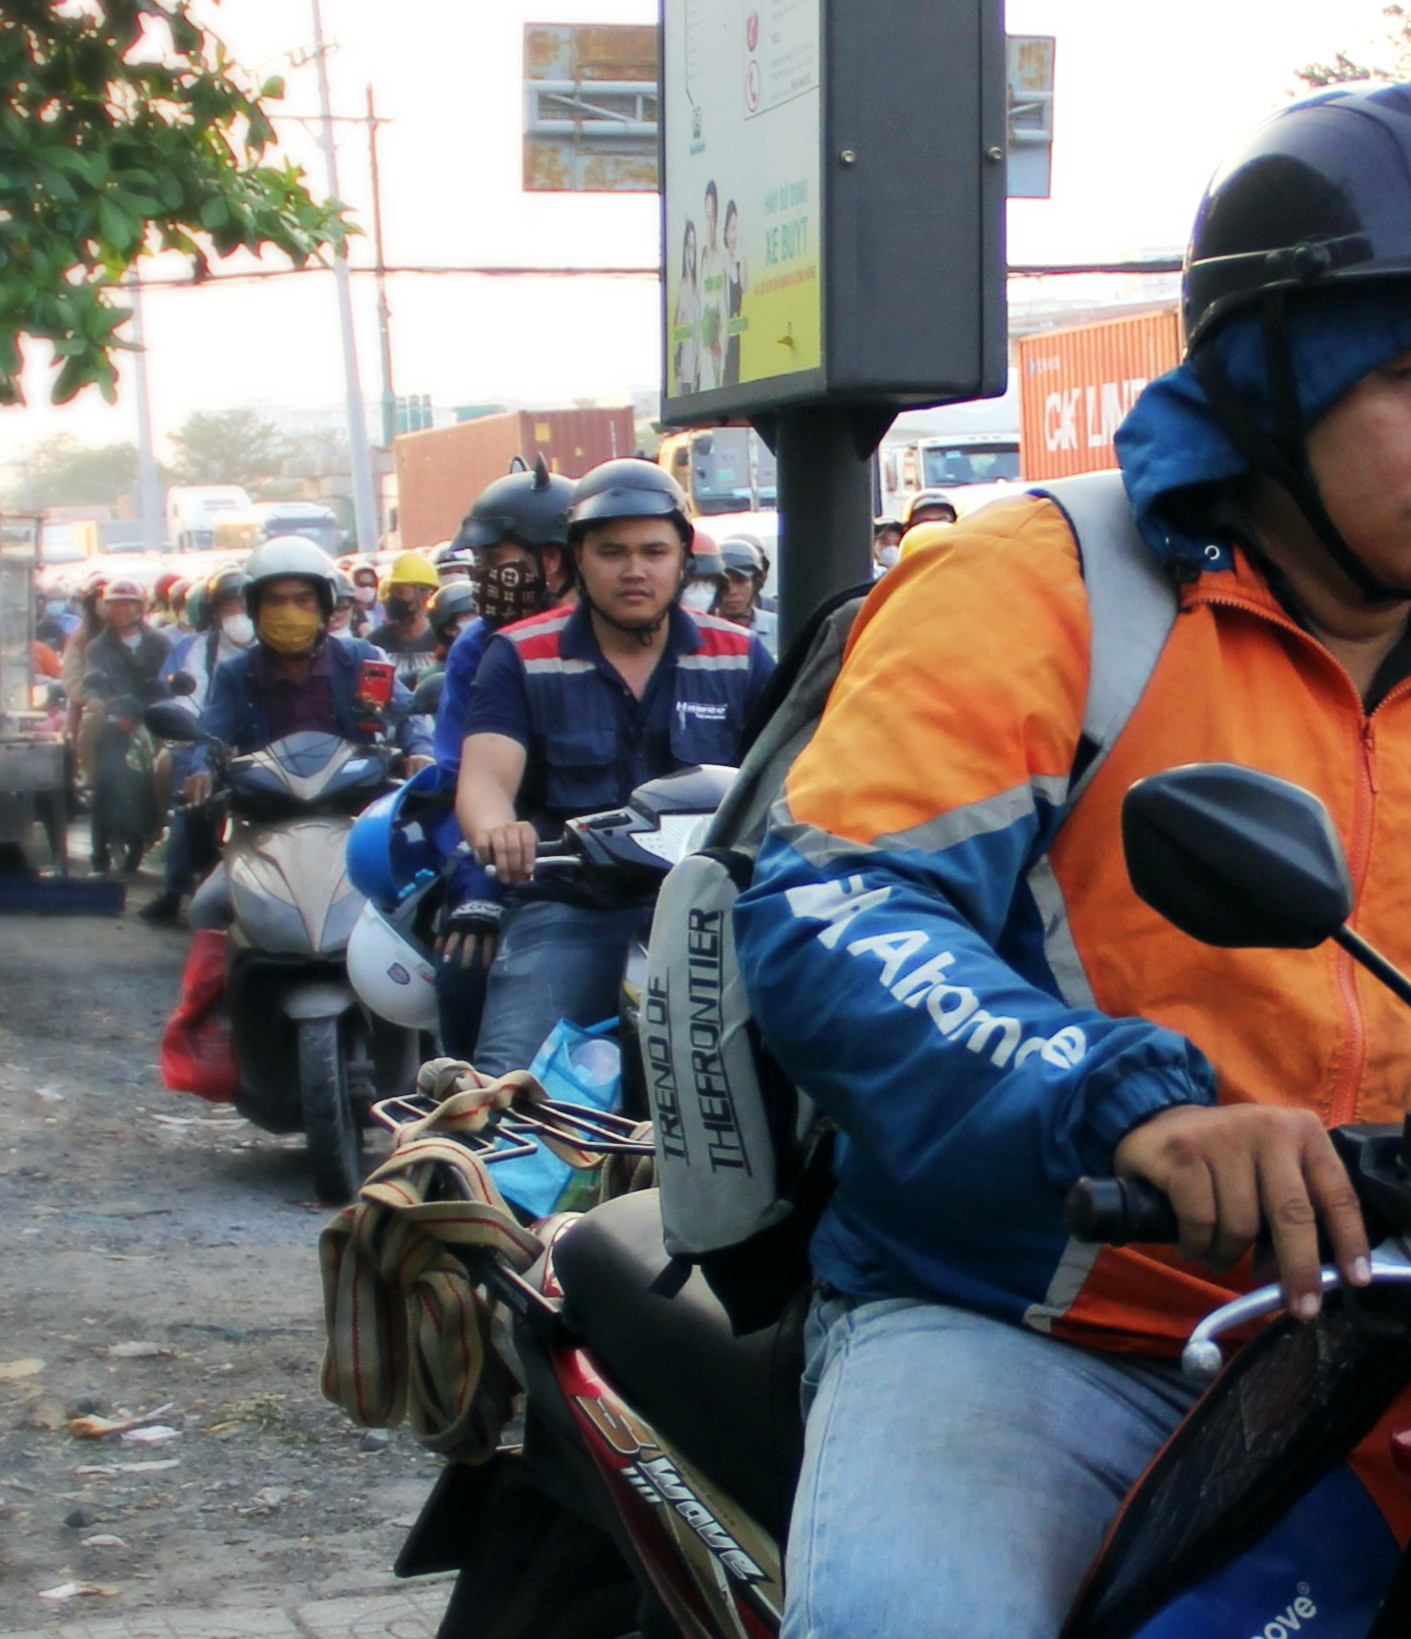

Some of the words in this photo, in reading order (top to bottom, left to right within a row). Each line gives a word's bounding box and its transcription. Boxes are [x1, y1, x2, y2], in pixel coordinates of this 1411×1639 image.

[1044, 388, 1082, 452] CK
[647, 975, 668, 1026] OF
[648, 1036, 689, 1161] TREND
